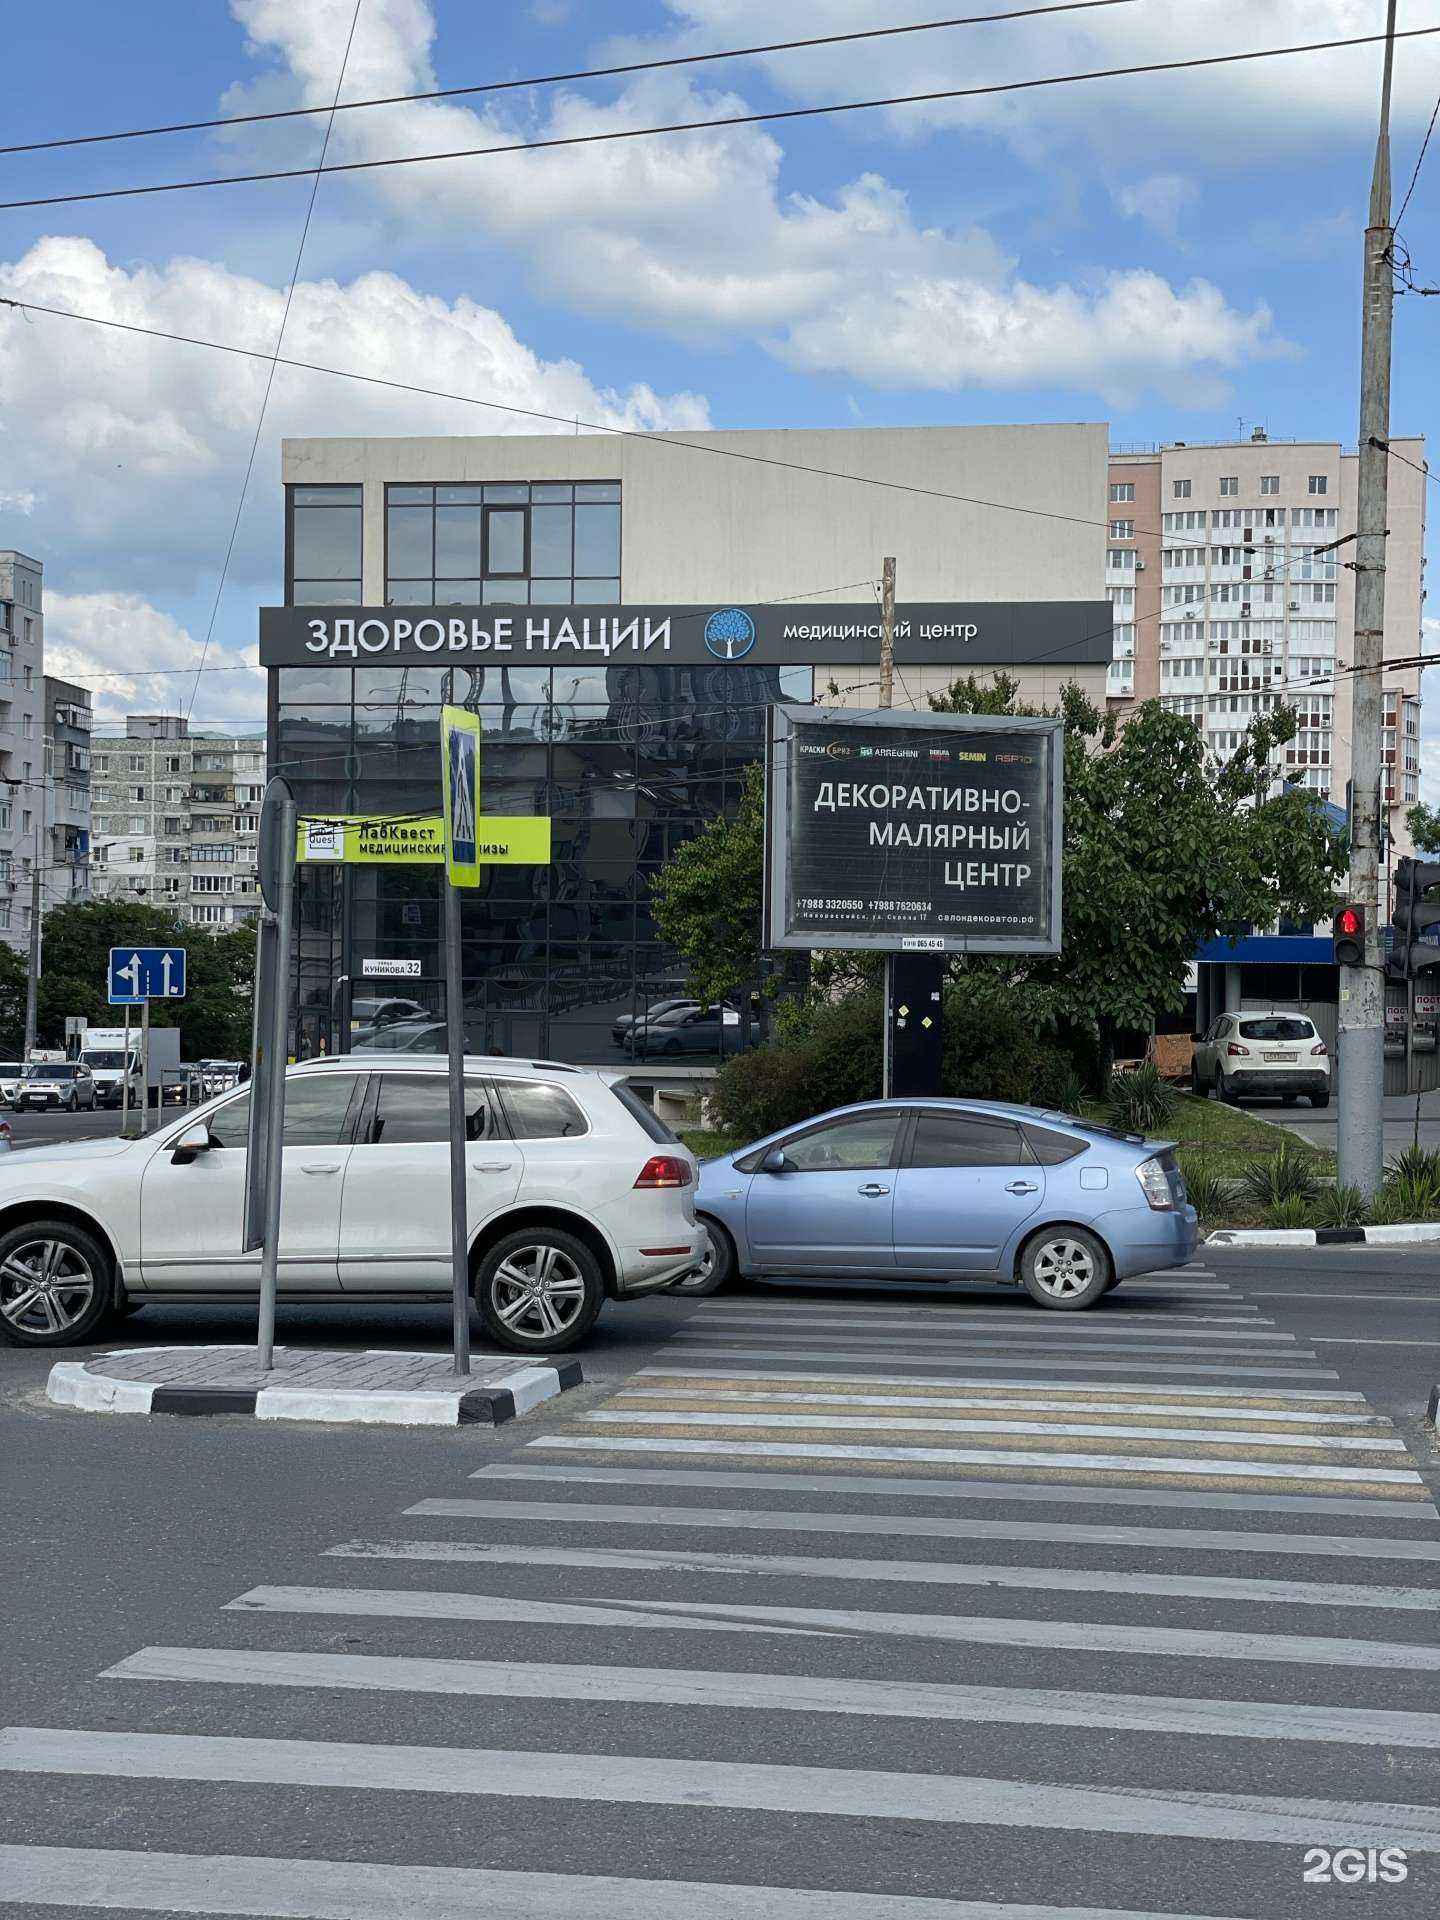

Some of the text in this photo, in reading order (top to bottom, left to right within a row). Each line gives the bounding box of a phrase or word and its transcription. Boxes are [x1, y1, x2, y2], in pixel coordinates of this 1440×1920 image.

[305, 616, 671, 657] ЗДОРОВЬЕ НАЦИИ
[920, 622, 978, 642] центр
[800, 745, 826, 754] КРАСКИ
[875, 748, 919, 758] ARREGHINI
[959, 751, 987, 762] SEMIN
[814, 782, 1030, 814] ДЕКОРАТИВНО-
[359, 822, 435, 839] ЛабКвест
[869, 820, 1030, 851] МАЛЯРНЫЙ
[944, 861, 1032, 891] ЦЕНТР
[825, 899, 864, 910] 3320550
[937, 914, 1034, 924] салондекоратор.рф
[364, 962, 420, 974] КУНИКОВА 32
